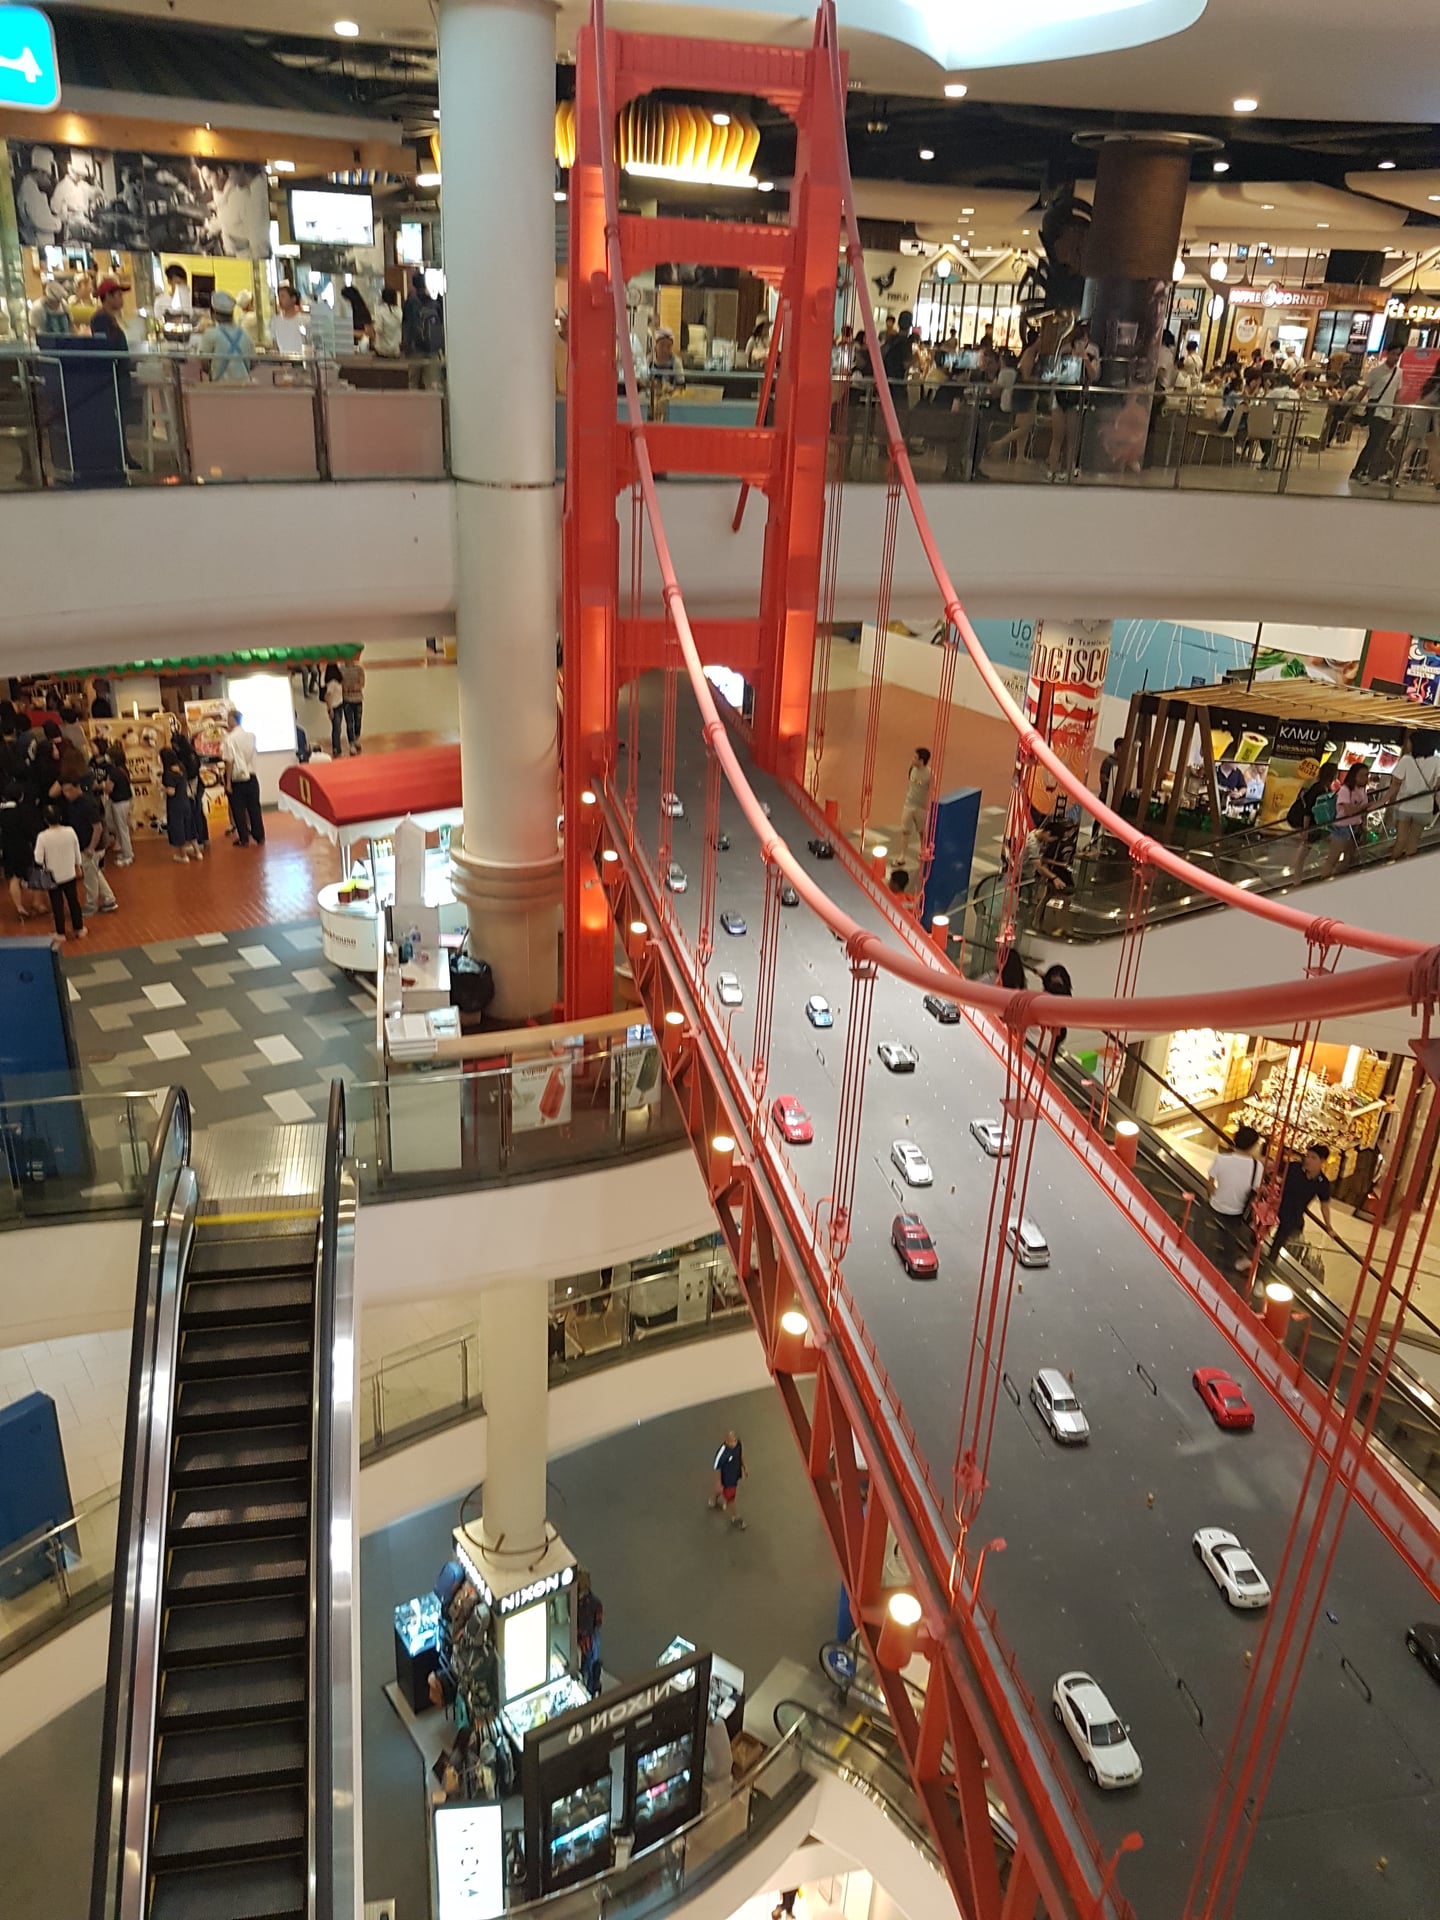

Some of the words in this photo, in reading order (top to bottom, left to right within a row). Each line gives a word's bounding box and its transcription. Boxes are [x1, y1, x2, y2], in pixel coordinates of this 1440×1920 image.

[1276, 291, 1325, 305] CORNER
[1280, 725, 1320, 742] KAMU
[1301, 760, 1319, 773] BEST
[501, 1573, 559, 1613] NIXON
